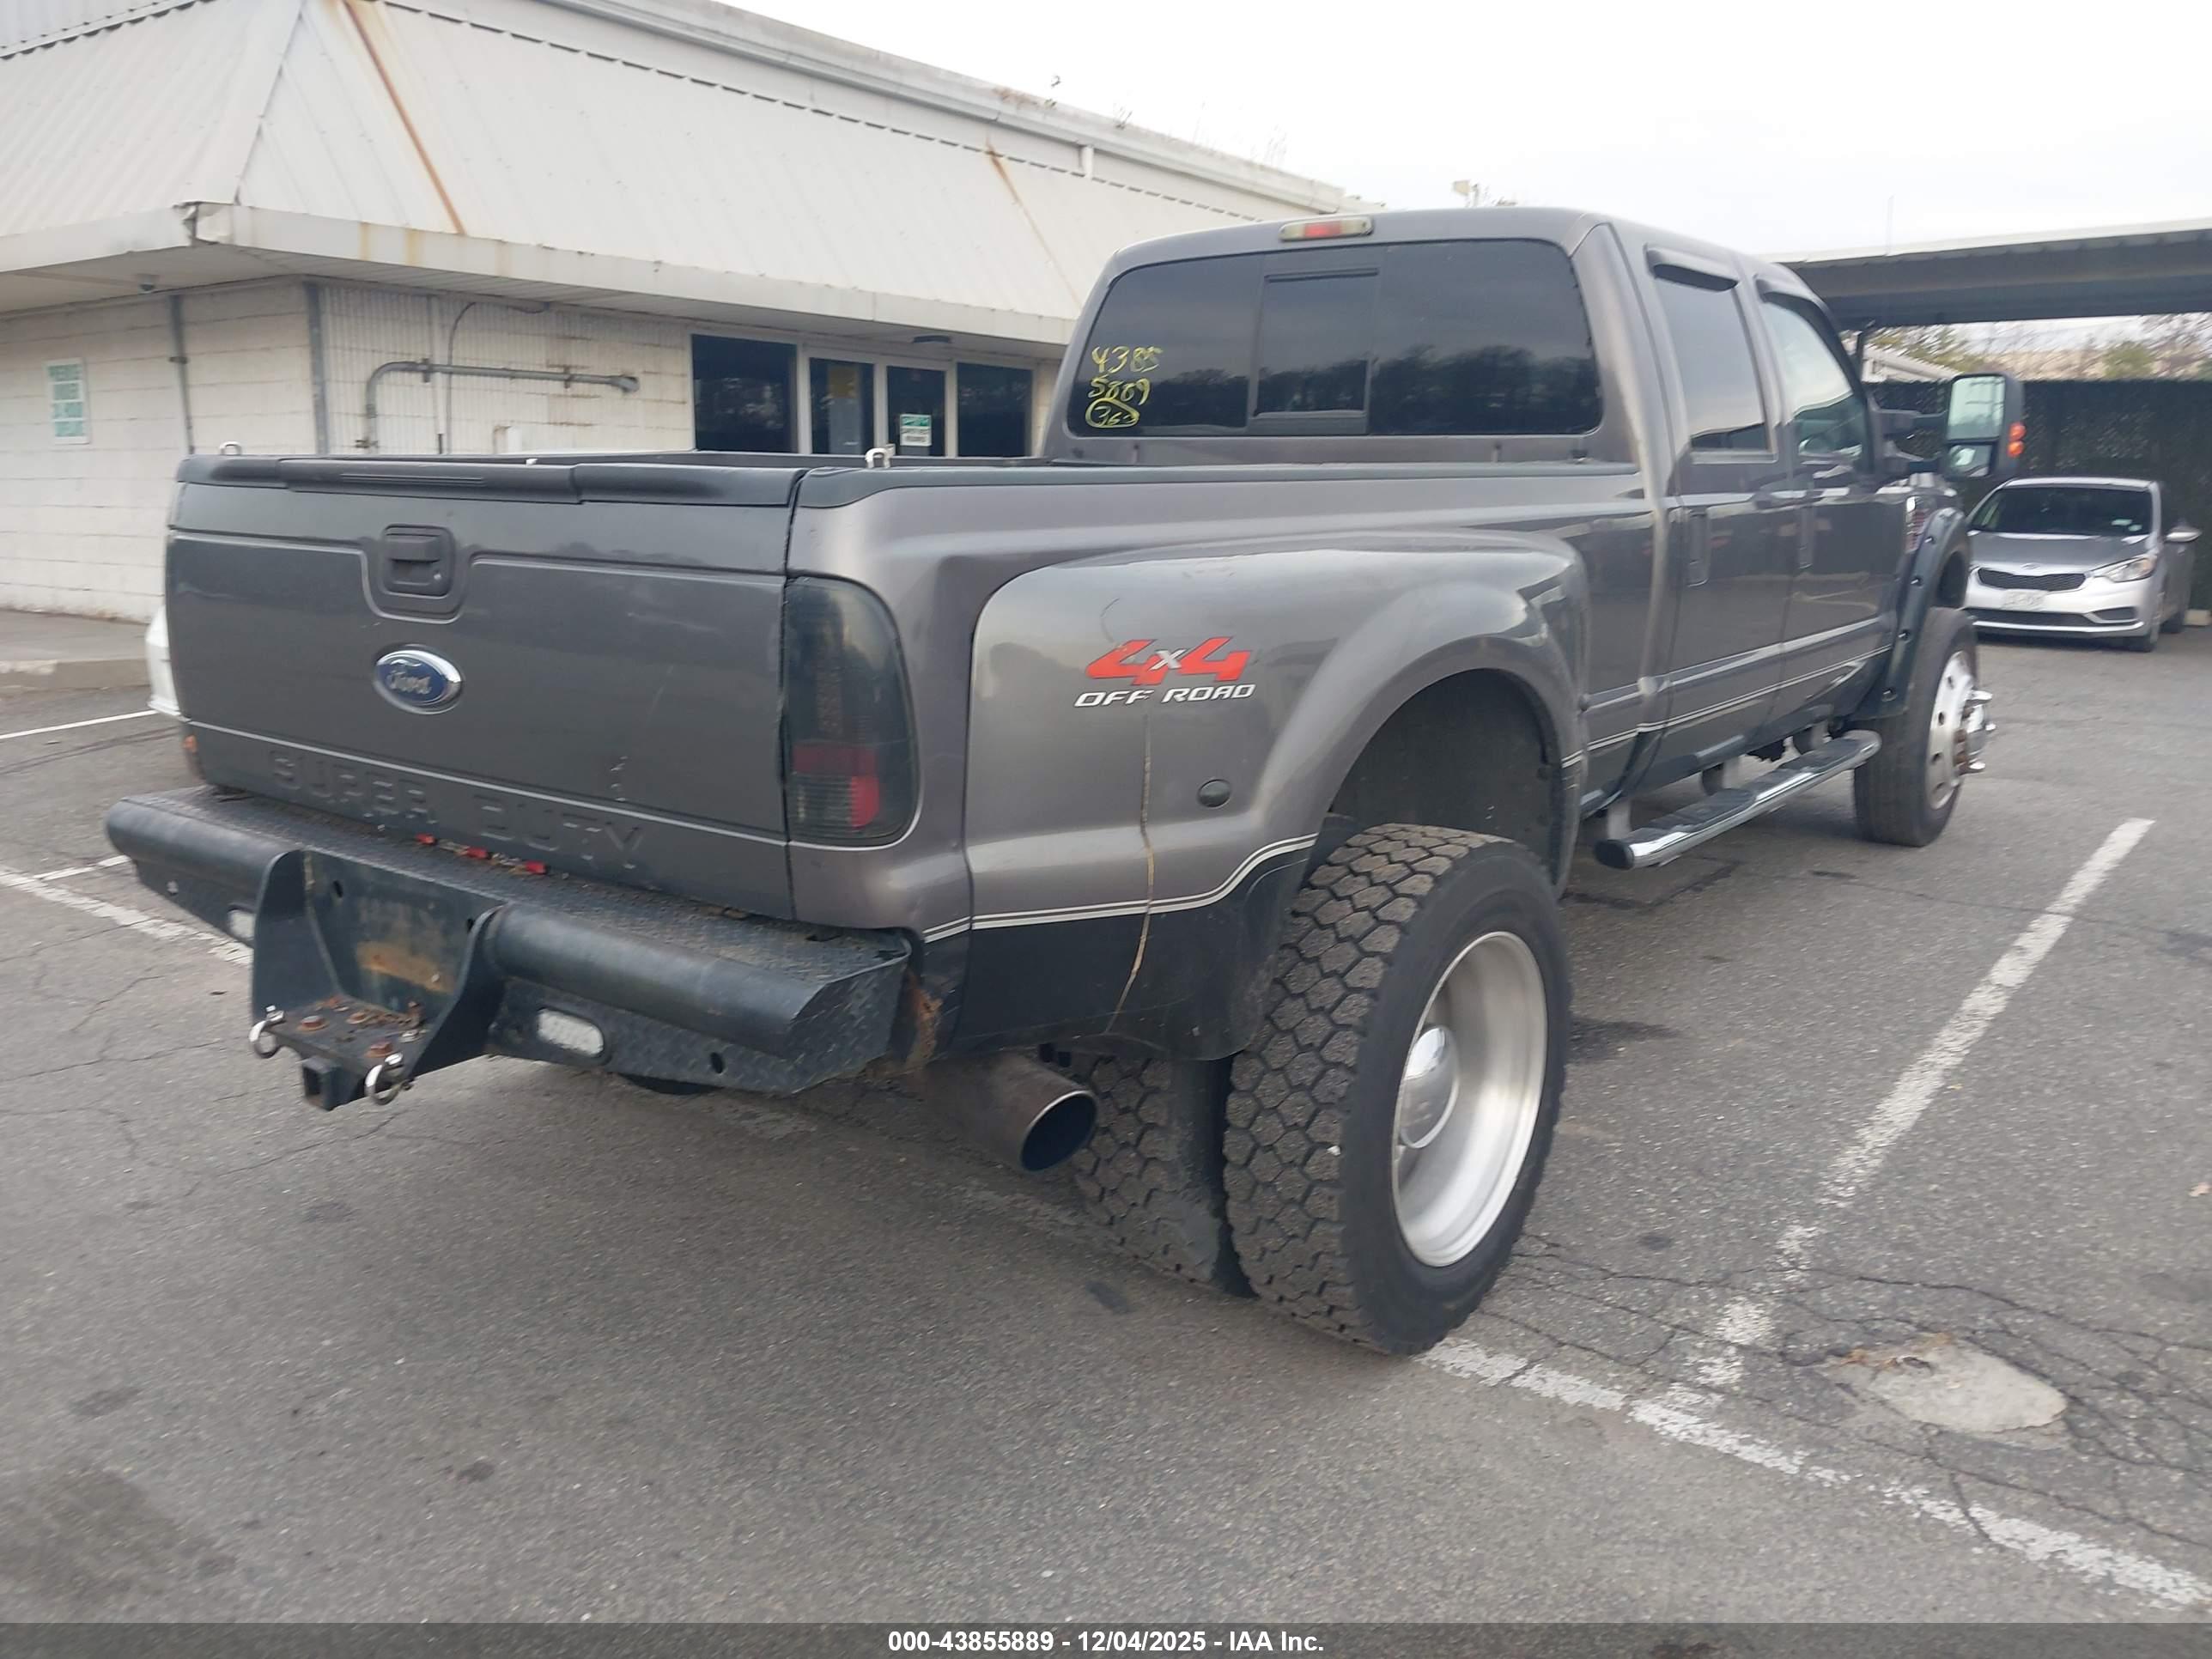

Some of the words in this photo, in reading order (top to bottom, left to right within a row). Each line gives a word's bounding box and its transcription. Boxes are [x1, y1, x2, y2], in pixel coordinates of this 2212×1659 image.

[1074, 690, 1155, 708] OFF
[1161, 684, 1256, 704] ROAD
[268, 749, 440, 826] SUPER
[473, 793, 646, 871] DUTY
